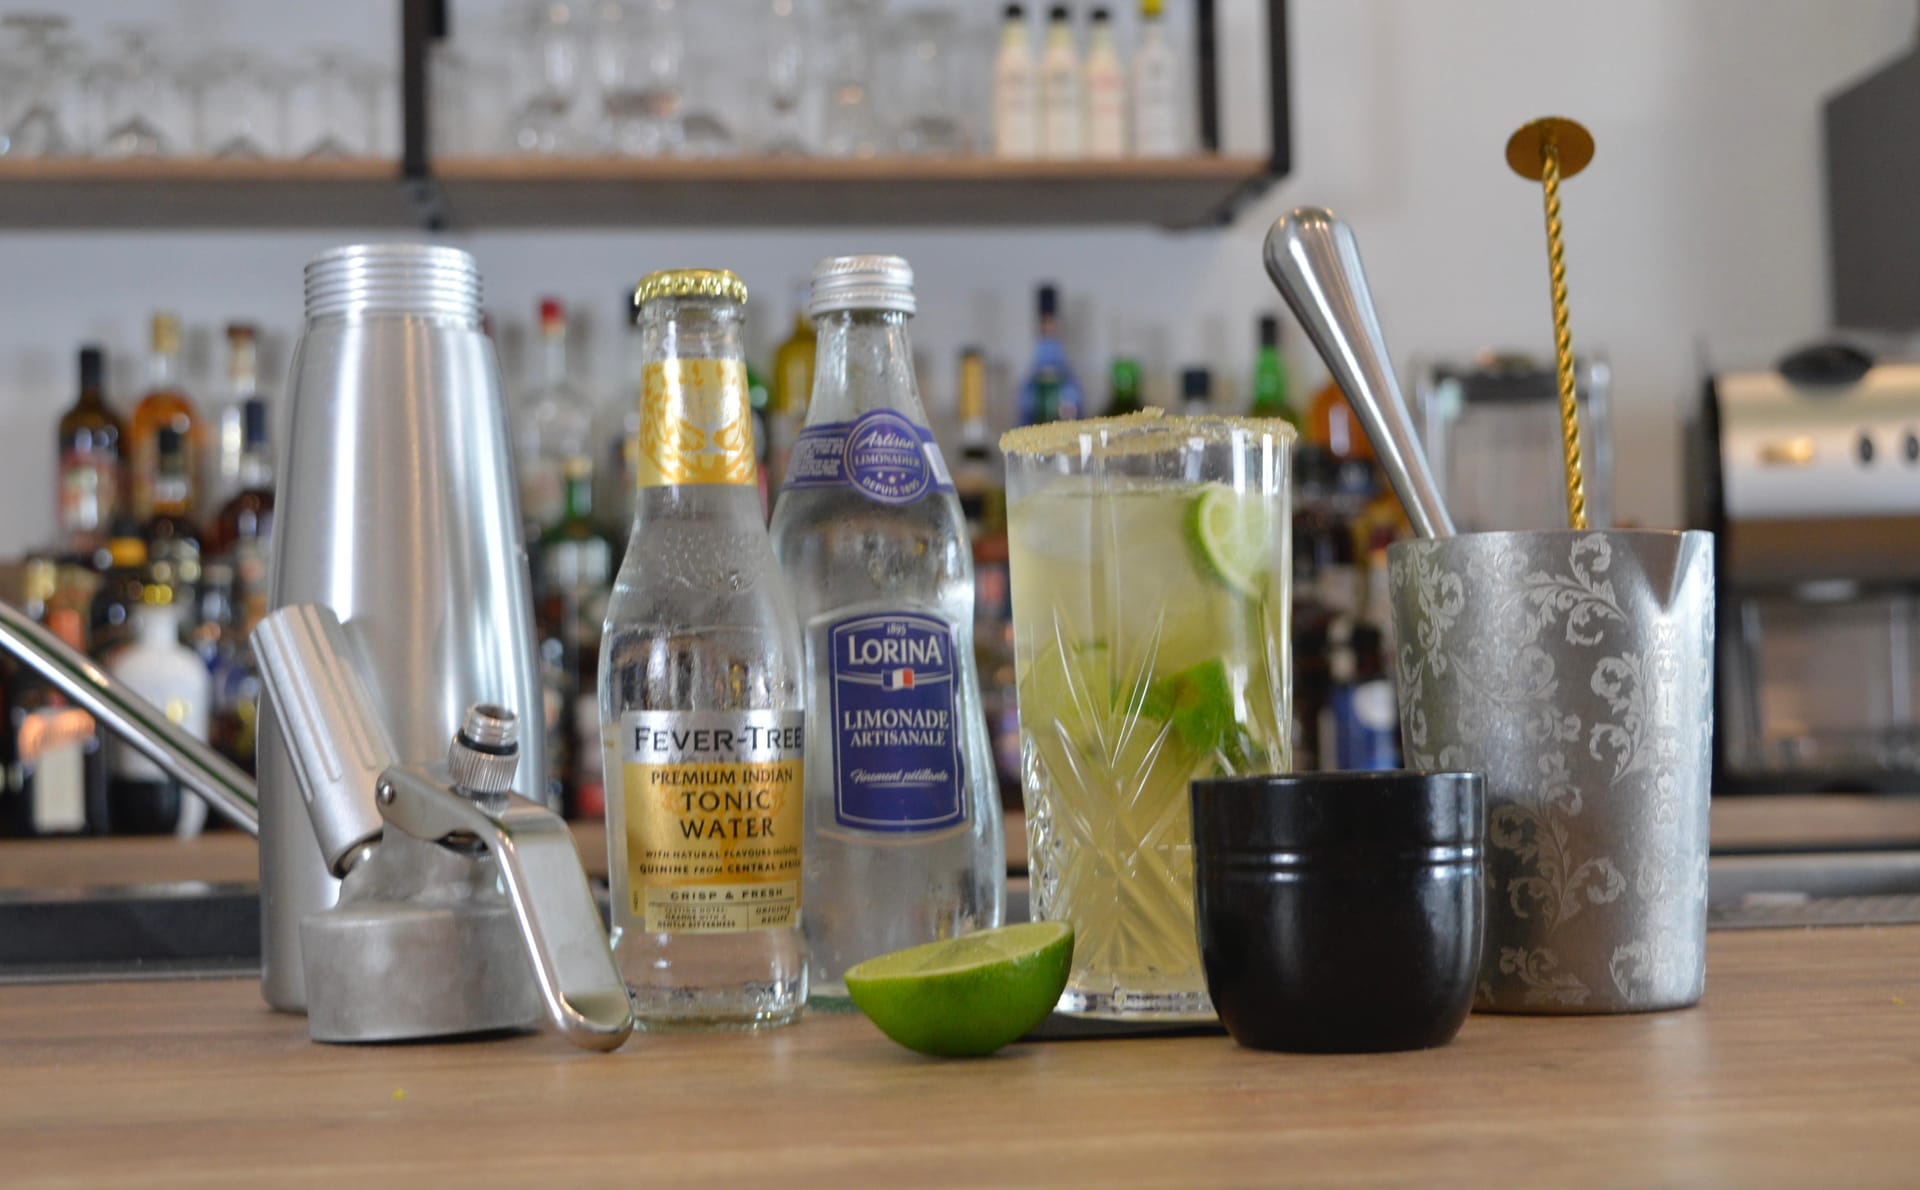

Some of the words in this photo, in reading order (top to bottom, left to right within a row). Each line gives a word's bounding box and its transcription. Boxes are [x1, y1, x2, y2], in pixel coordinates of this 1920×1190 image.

[856, 430, 916, 450] Artisan
[862, 476, 899, 497] DEPUIS
[848, 635, 943, 666] LORINA
[844, 708, 949, 731] LIMONADE
[634, 726, 802, 752] FEVER-TREE
[850, 730, 946, 747] ARTISANALE
[651, 770, 736, 785] PREMIUM
[742, 768, 793, 784] INDIAN
[681, 790, 770, 813] TONIC
[680, 817, 776, 839] WATER
[645, 850, 670, 859] WITH
[673, 849, 721, 859] NATURAL
[724, 848, 771, 858] FLAVOURS
[640, 863, 689, 875] QUININE
[694, 865, 723, 875] FROM
[727, 862, 775, 874] CENTRAL
[670, 890, 717, 901] CRISP
[725, 890, 734, 900] &
[742, 888, 783, 899] FRESH
